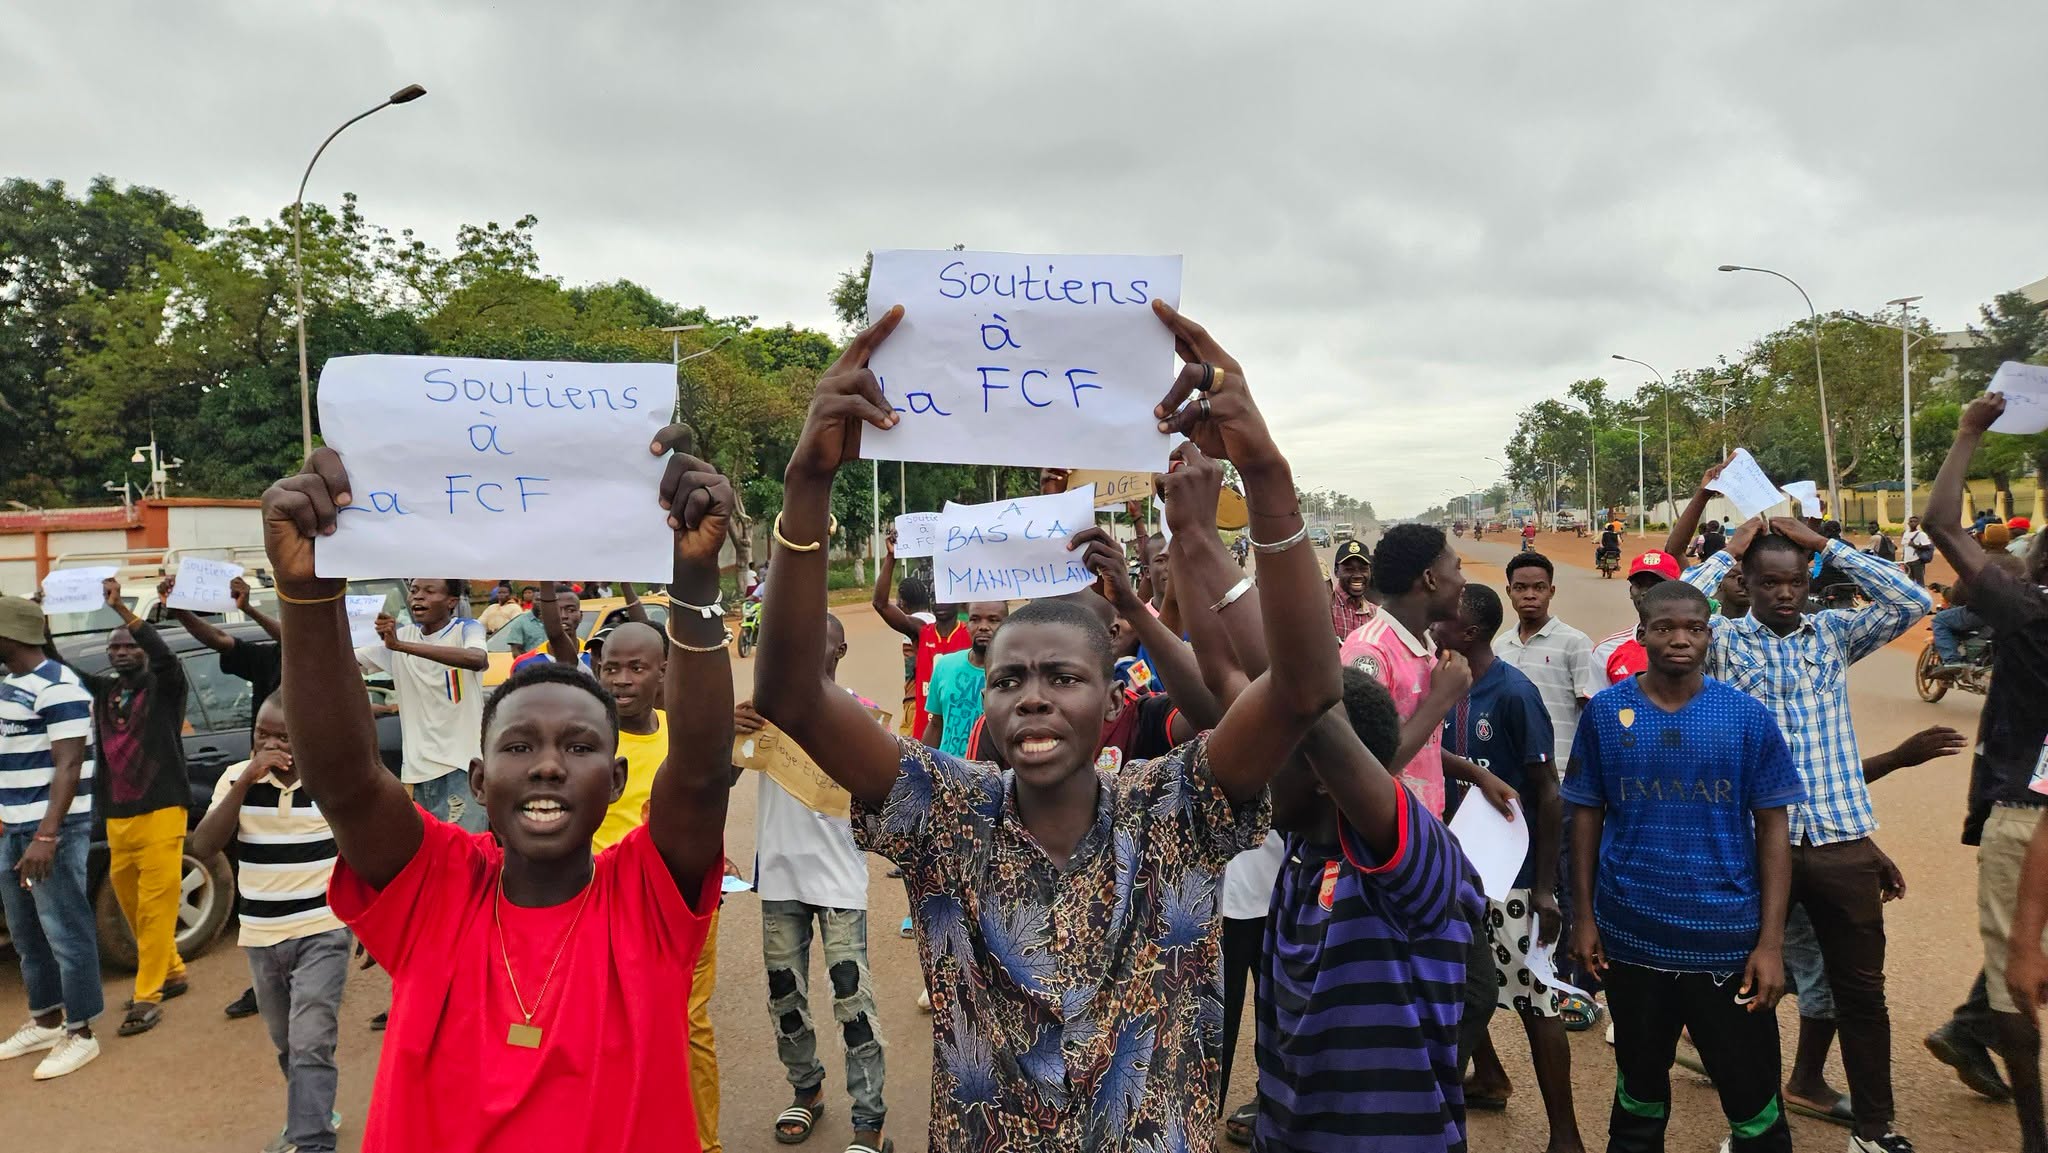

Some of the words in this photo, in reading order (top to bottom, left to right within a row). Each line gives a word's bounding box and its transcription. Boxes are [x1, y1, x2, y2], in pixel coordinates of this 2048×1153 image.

[940, 261, 1148, 304] Soutiens
[981, 314, 1022, 350] à
[424, 368, 638, 410] Soutiens
[976, 367, 1103, 413] FCF
[468, 411, 514, 455] à
[445, 475, 551, 514] FCF
[906, 515, 938, 523] Soutie
[947, 524, 1008, 552] BAS
[1025, 520, 1072, 539] LA
[916, 536, 935, 548] FC
[1620, 777, 1732, 803] EMAAR
